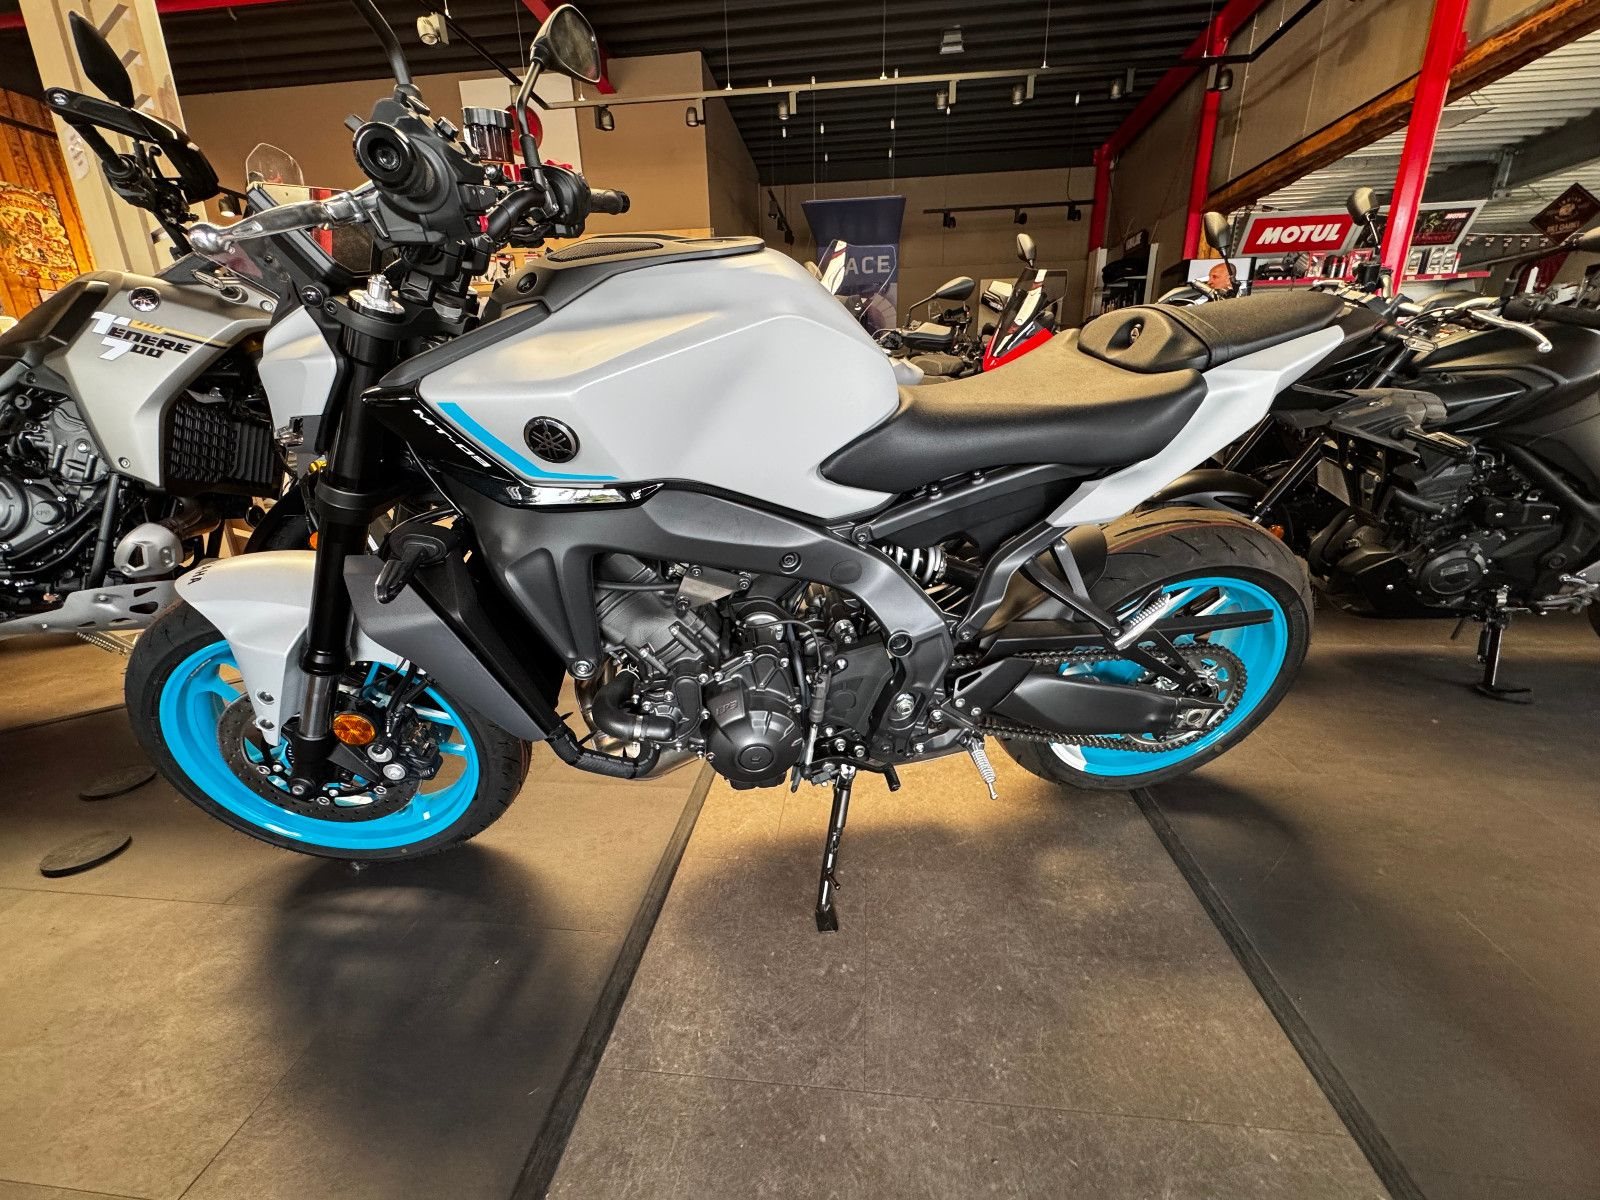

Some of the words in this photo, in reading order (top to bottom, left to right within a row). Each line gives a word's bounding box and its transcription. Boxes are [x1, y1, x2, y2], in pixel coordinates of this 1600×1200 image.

[1255, 223, 1342, 245] MOTUL
[844, 255, 892, 277] ACE
[99, 336, 164, 361] 700
[412, 409, 491, 468] MT-09
